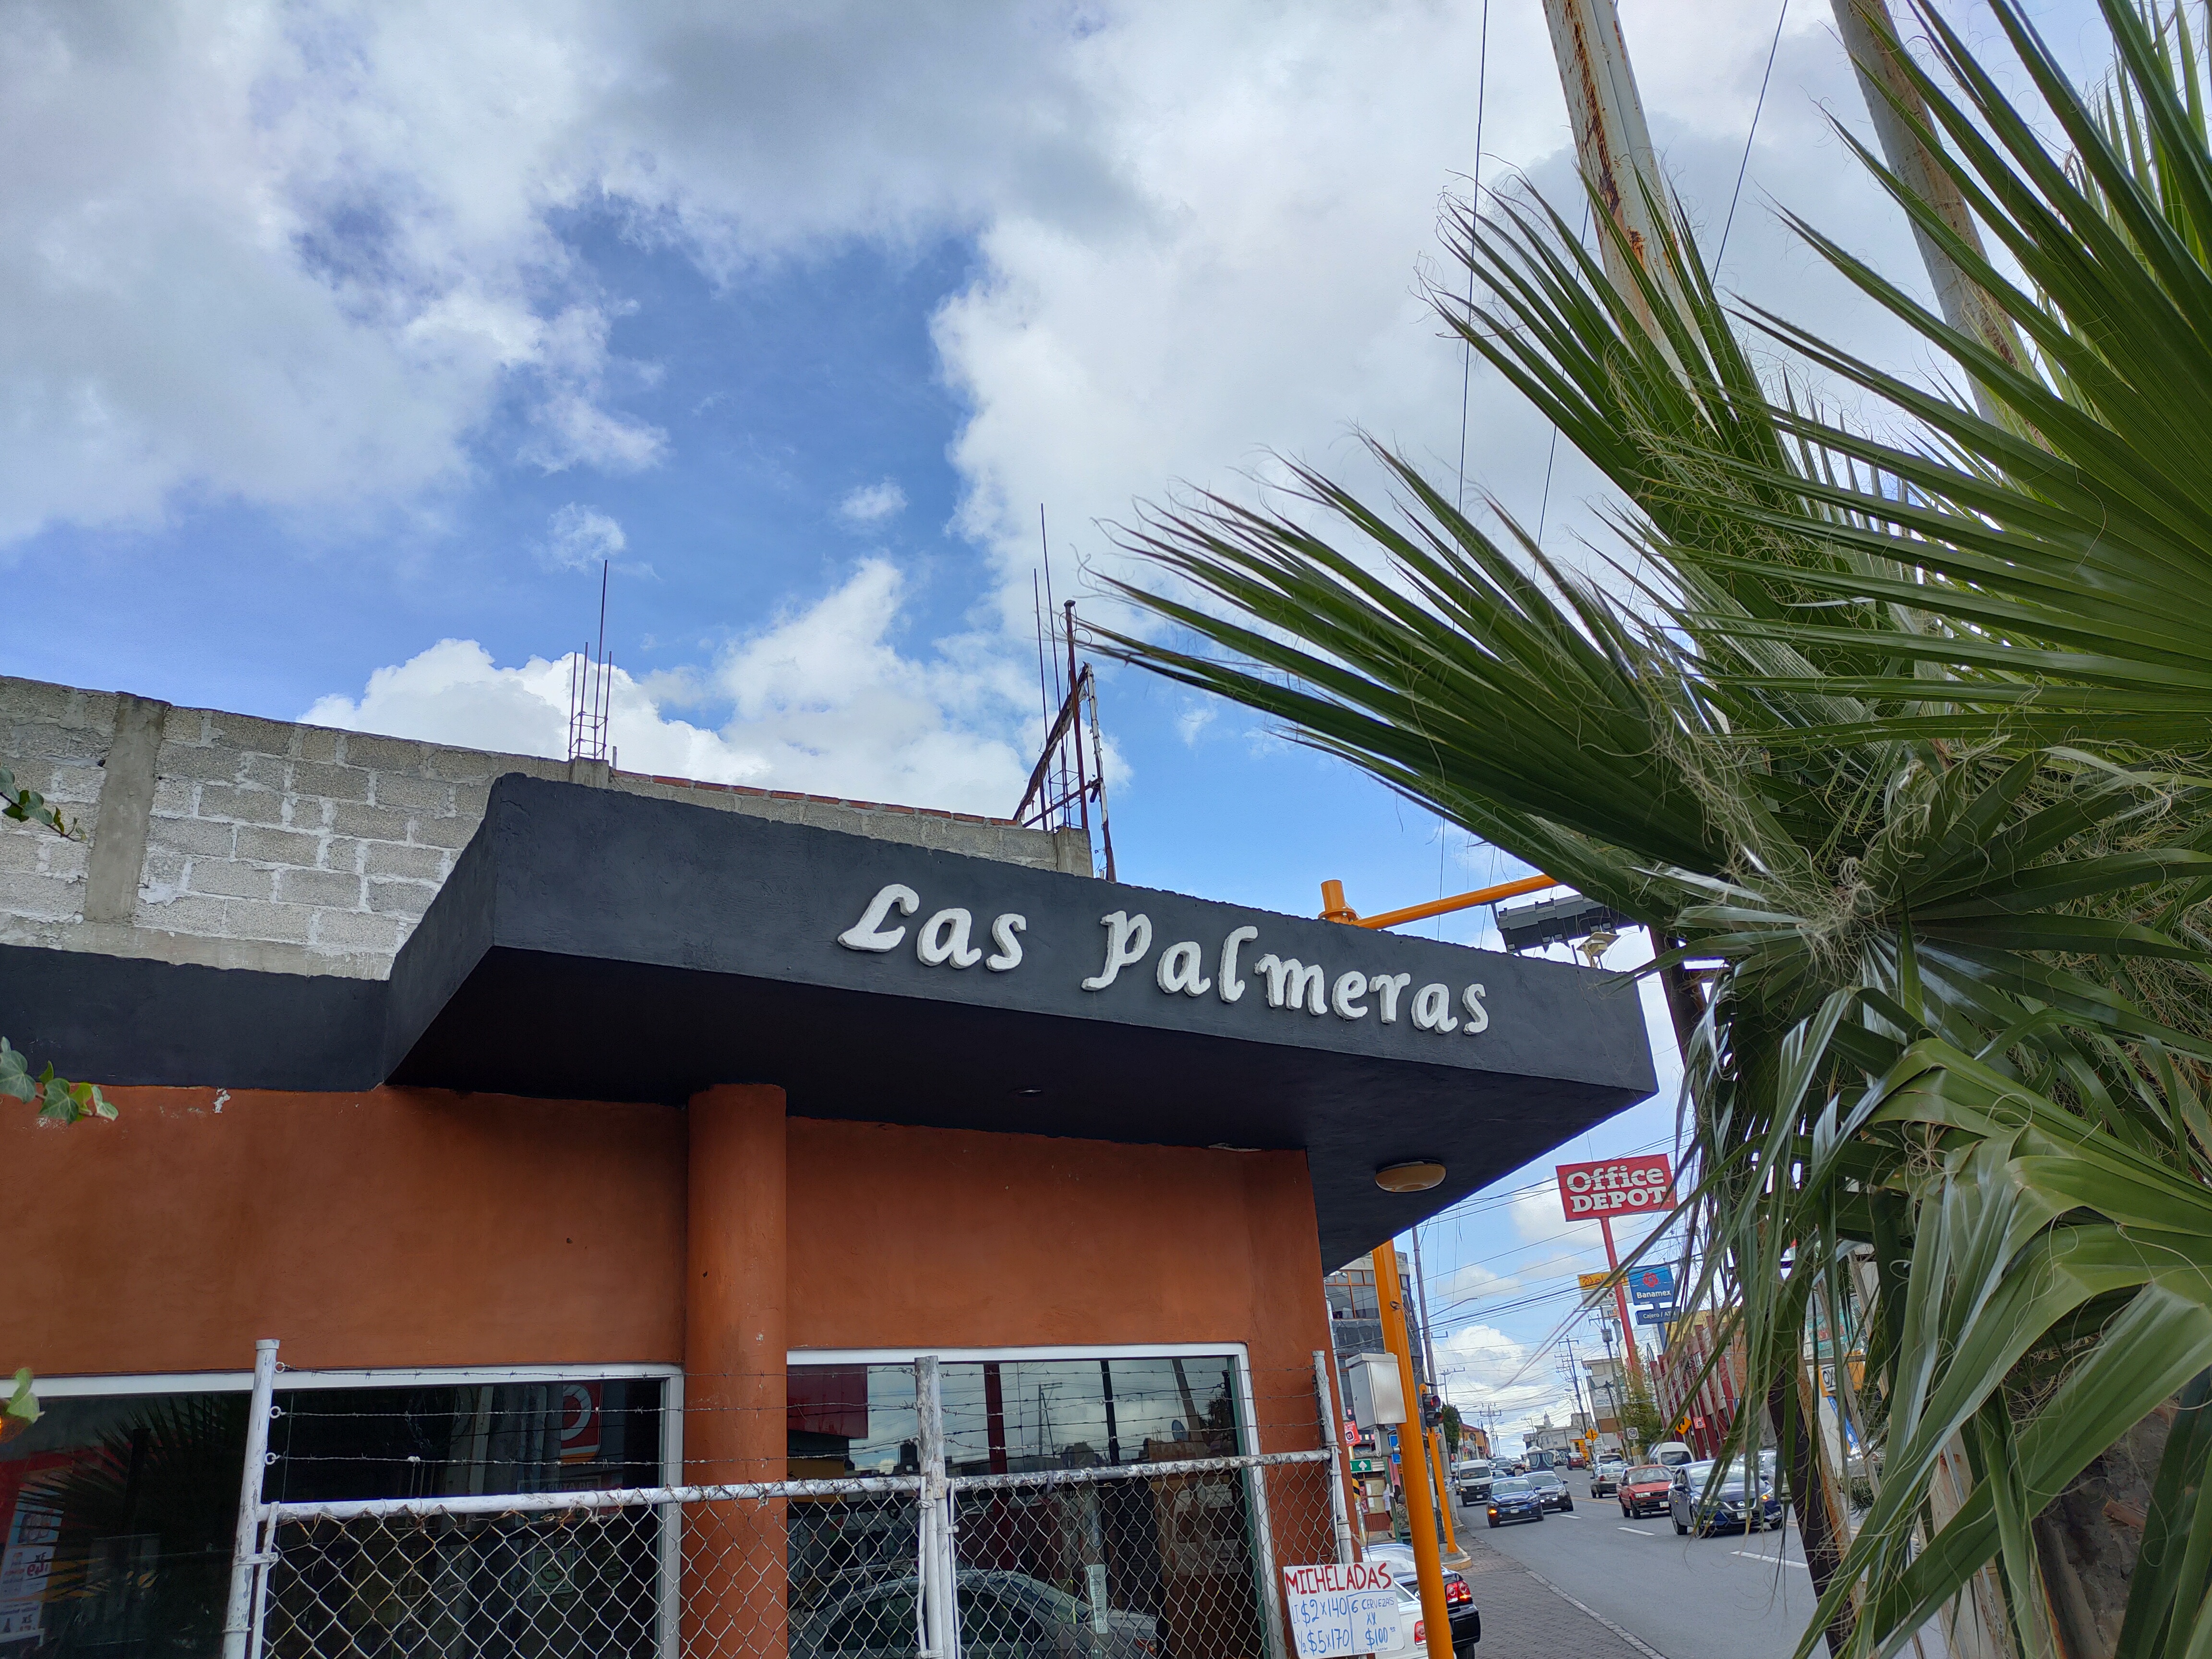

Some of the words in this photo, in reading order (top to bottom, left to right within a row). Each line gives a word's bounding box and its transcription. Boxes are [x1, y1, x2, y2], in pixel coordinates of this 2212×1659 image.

[837, 884, 1026, 972] Las
[1081, 910, 1490, 1035] Palmeras
[1566, 1166, 1664, 1193] Office
[1570, 1186, 1668, 1213] DEPOT
[1636, 1290, 1671, 1299] Banamex
[1285, 1562, 1392, 1597] MICHELADAS
[1351, 1599, 1358, 1613] 6
[1361, 1597, 1395, 1610] CERVEZAS
[1366, 1612, 1377, 1625] XX
